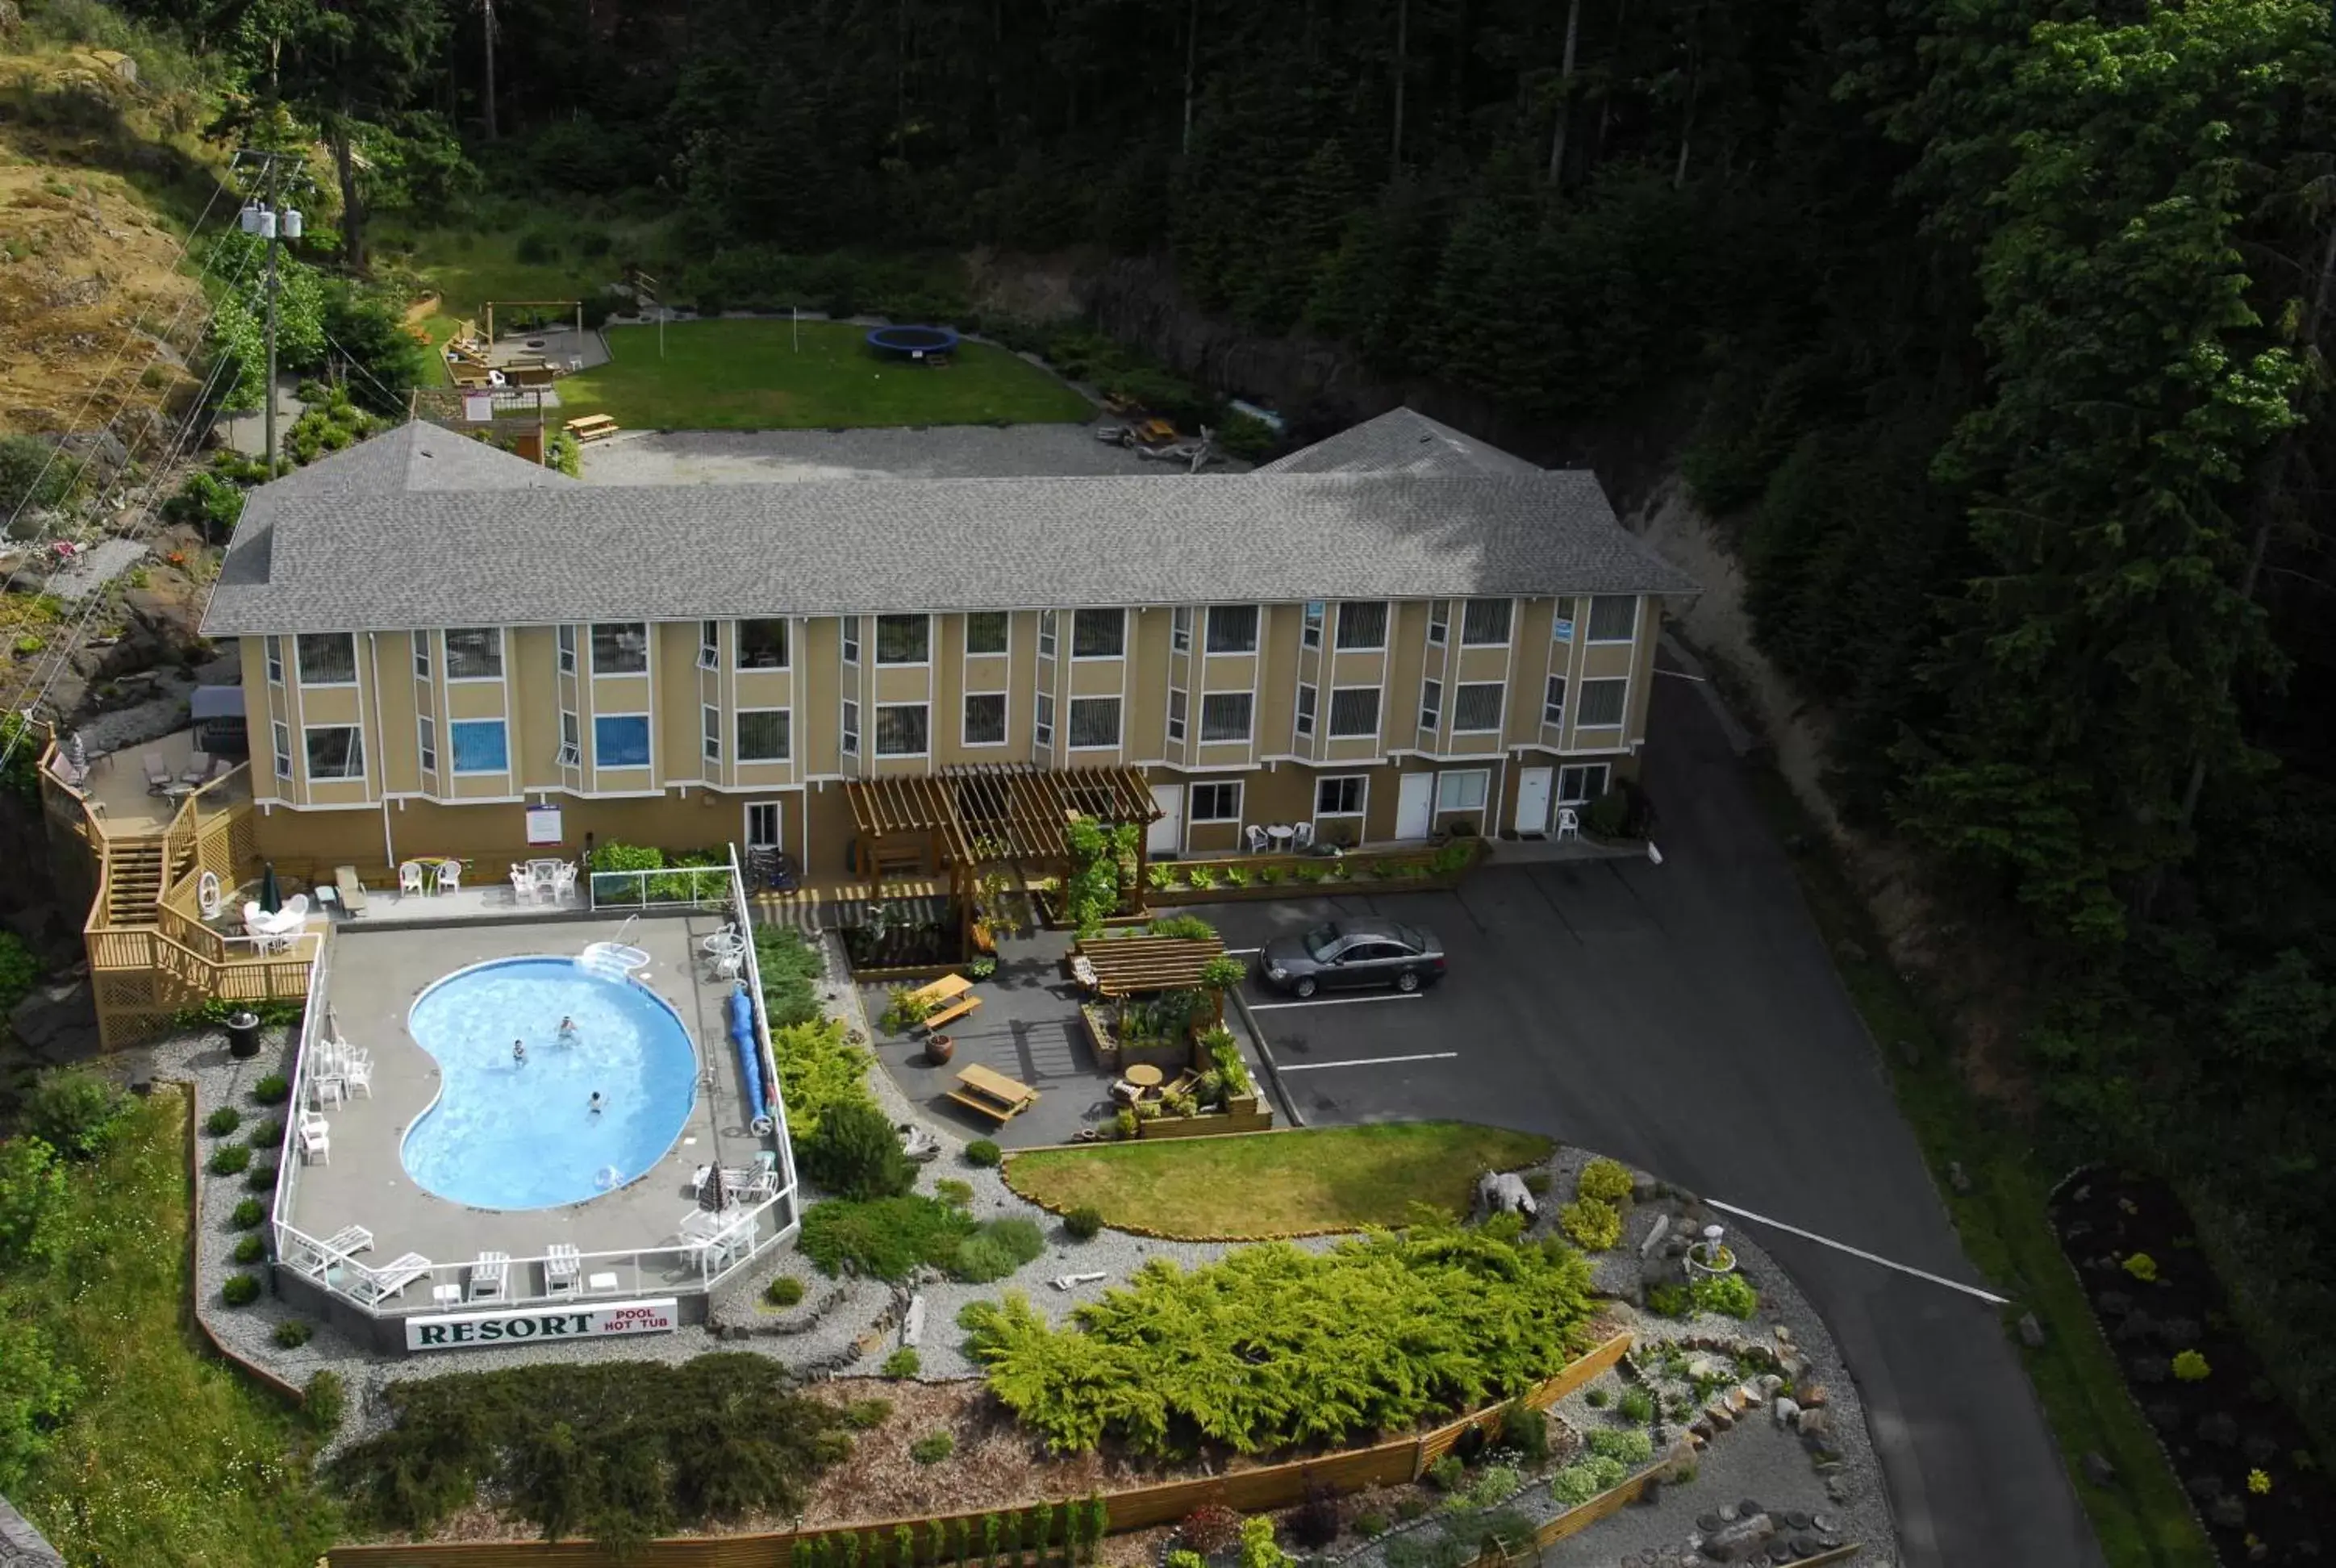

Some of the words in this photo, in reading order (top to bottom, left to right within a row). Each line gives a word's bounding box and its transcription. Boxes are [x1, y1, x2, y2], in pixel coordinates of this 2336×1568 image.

[615, 1308, 655, 1320] POOL
[419, 1314, 594, 1345] RESORT
[604, 1320, 633, 1332] HOT
[640, 1318, 668, 1328] TUB
